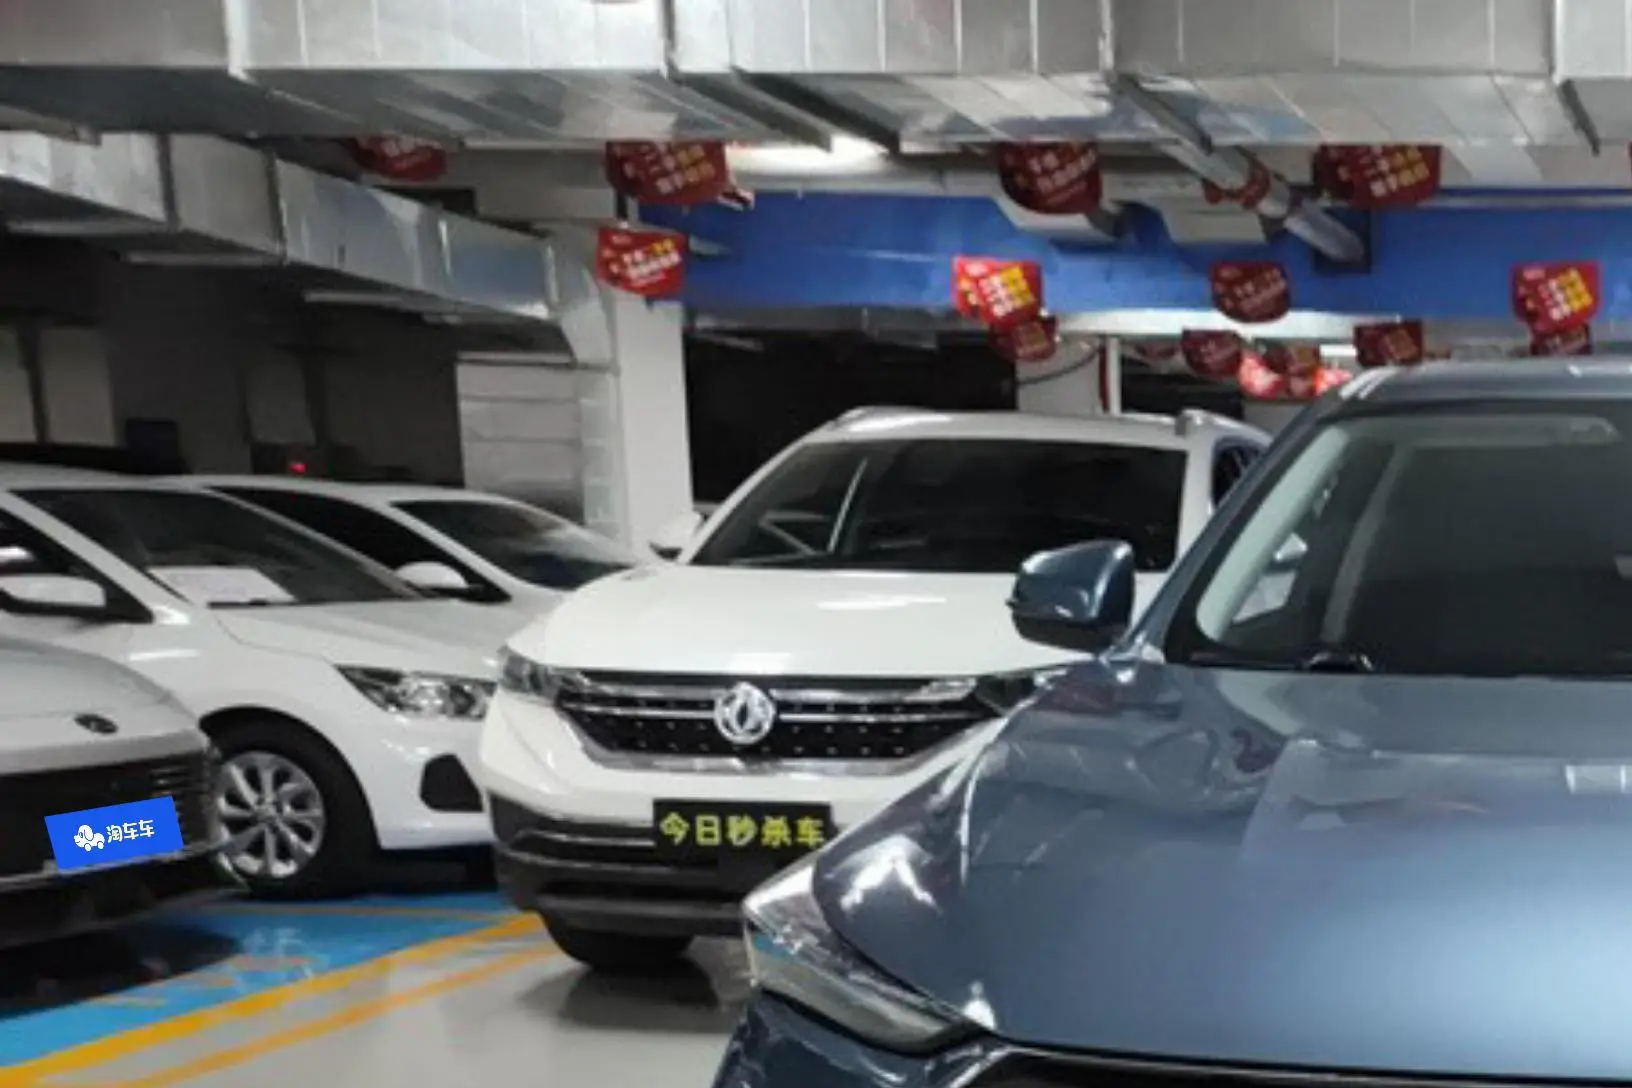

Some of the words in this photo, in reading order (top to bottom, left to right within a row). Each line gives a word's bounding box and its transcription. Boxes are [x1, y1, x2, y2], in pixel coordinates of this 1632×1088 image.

[659, 811, 825, 848] 今日秒杀车
